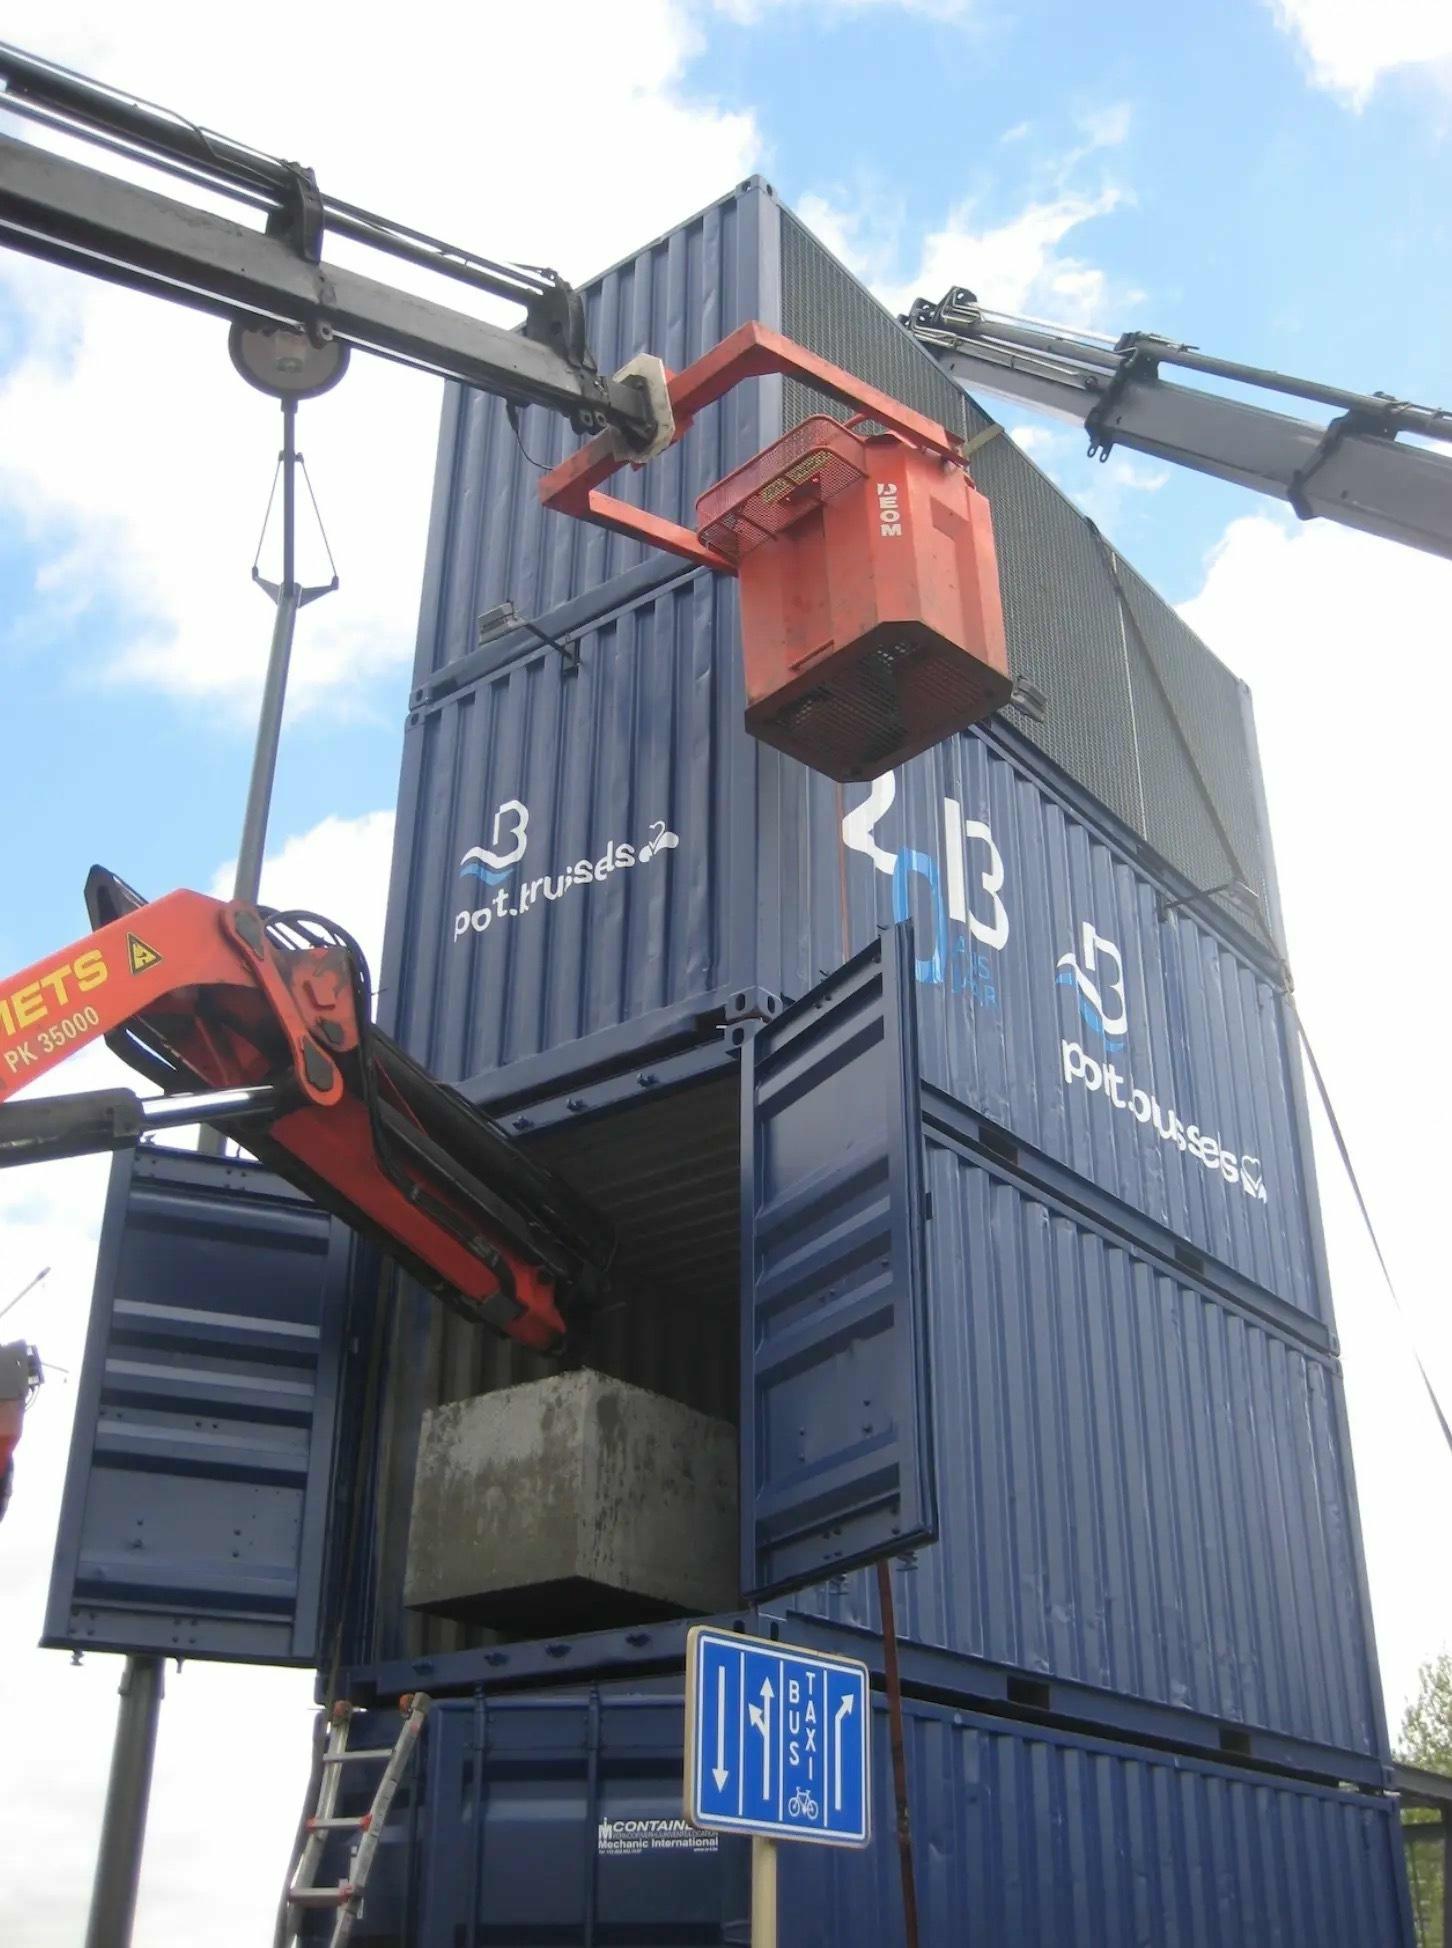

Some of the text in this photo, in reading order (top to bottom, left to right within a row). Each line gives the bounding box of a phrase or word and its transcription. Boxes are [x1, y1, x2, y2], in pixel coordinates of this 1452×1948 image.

[4, 1005, 100, 1074] PK 35000
[788, 1679, 800, 1766] BUS
[805, 1671, 817, 1781] TAXI
[598, 1835, 719, 1849] Mechanic International
